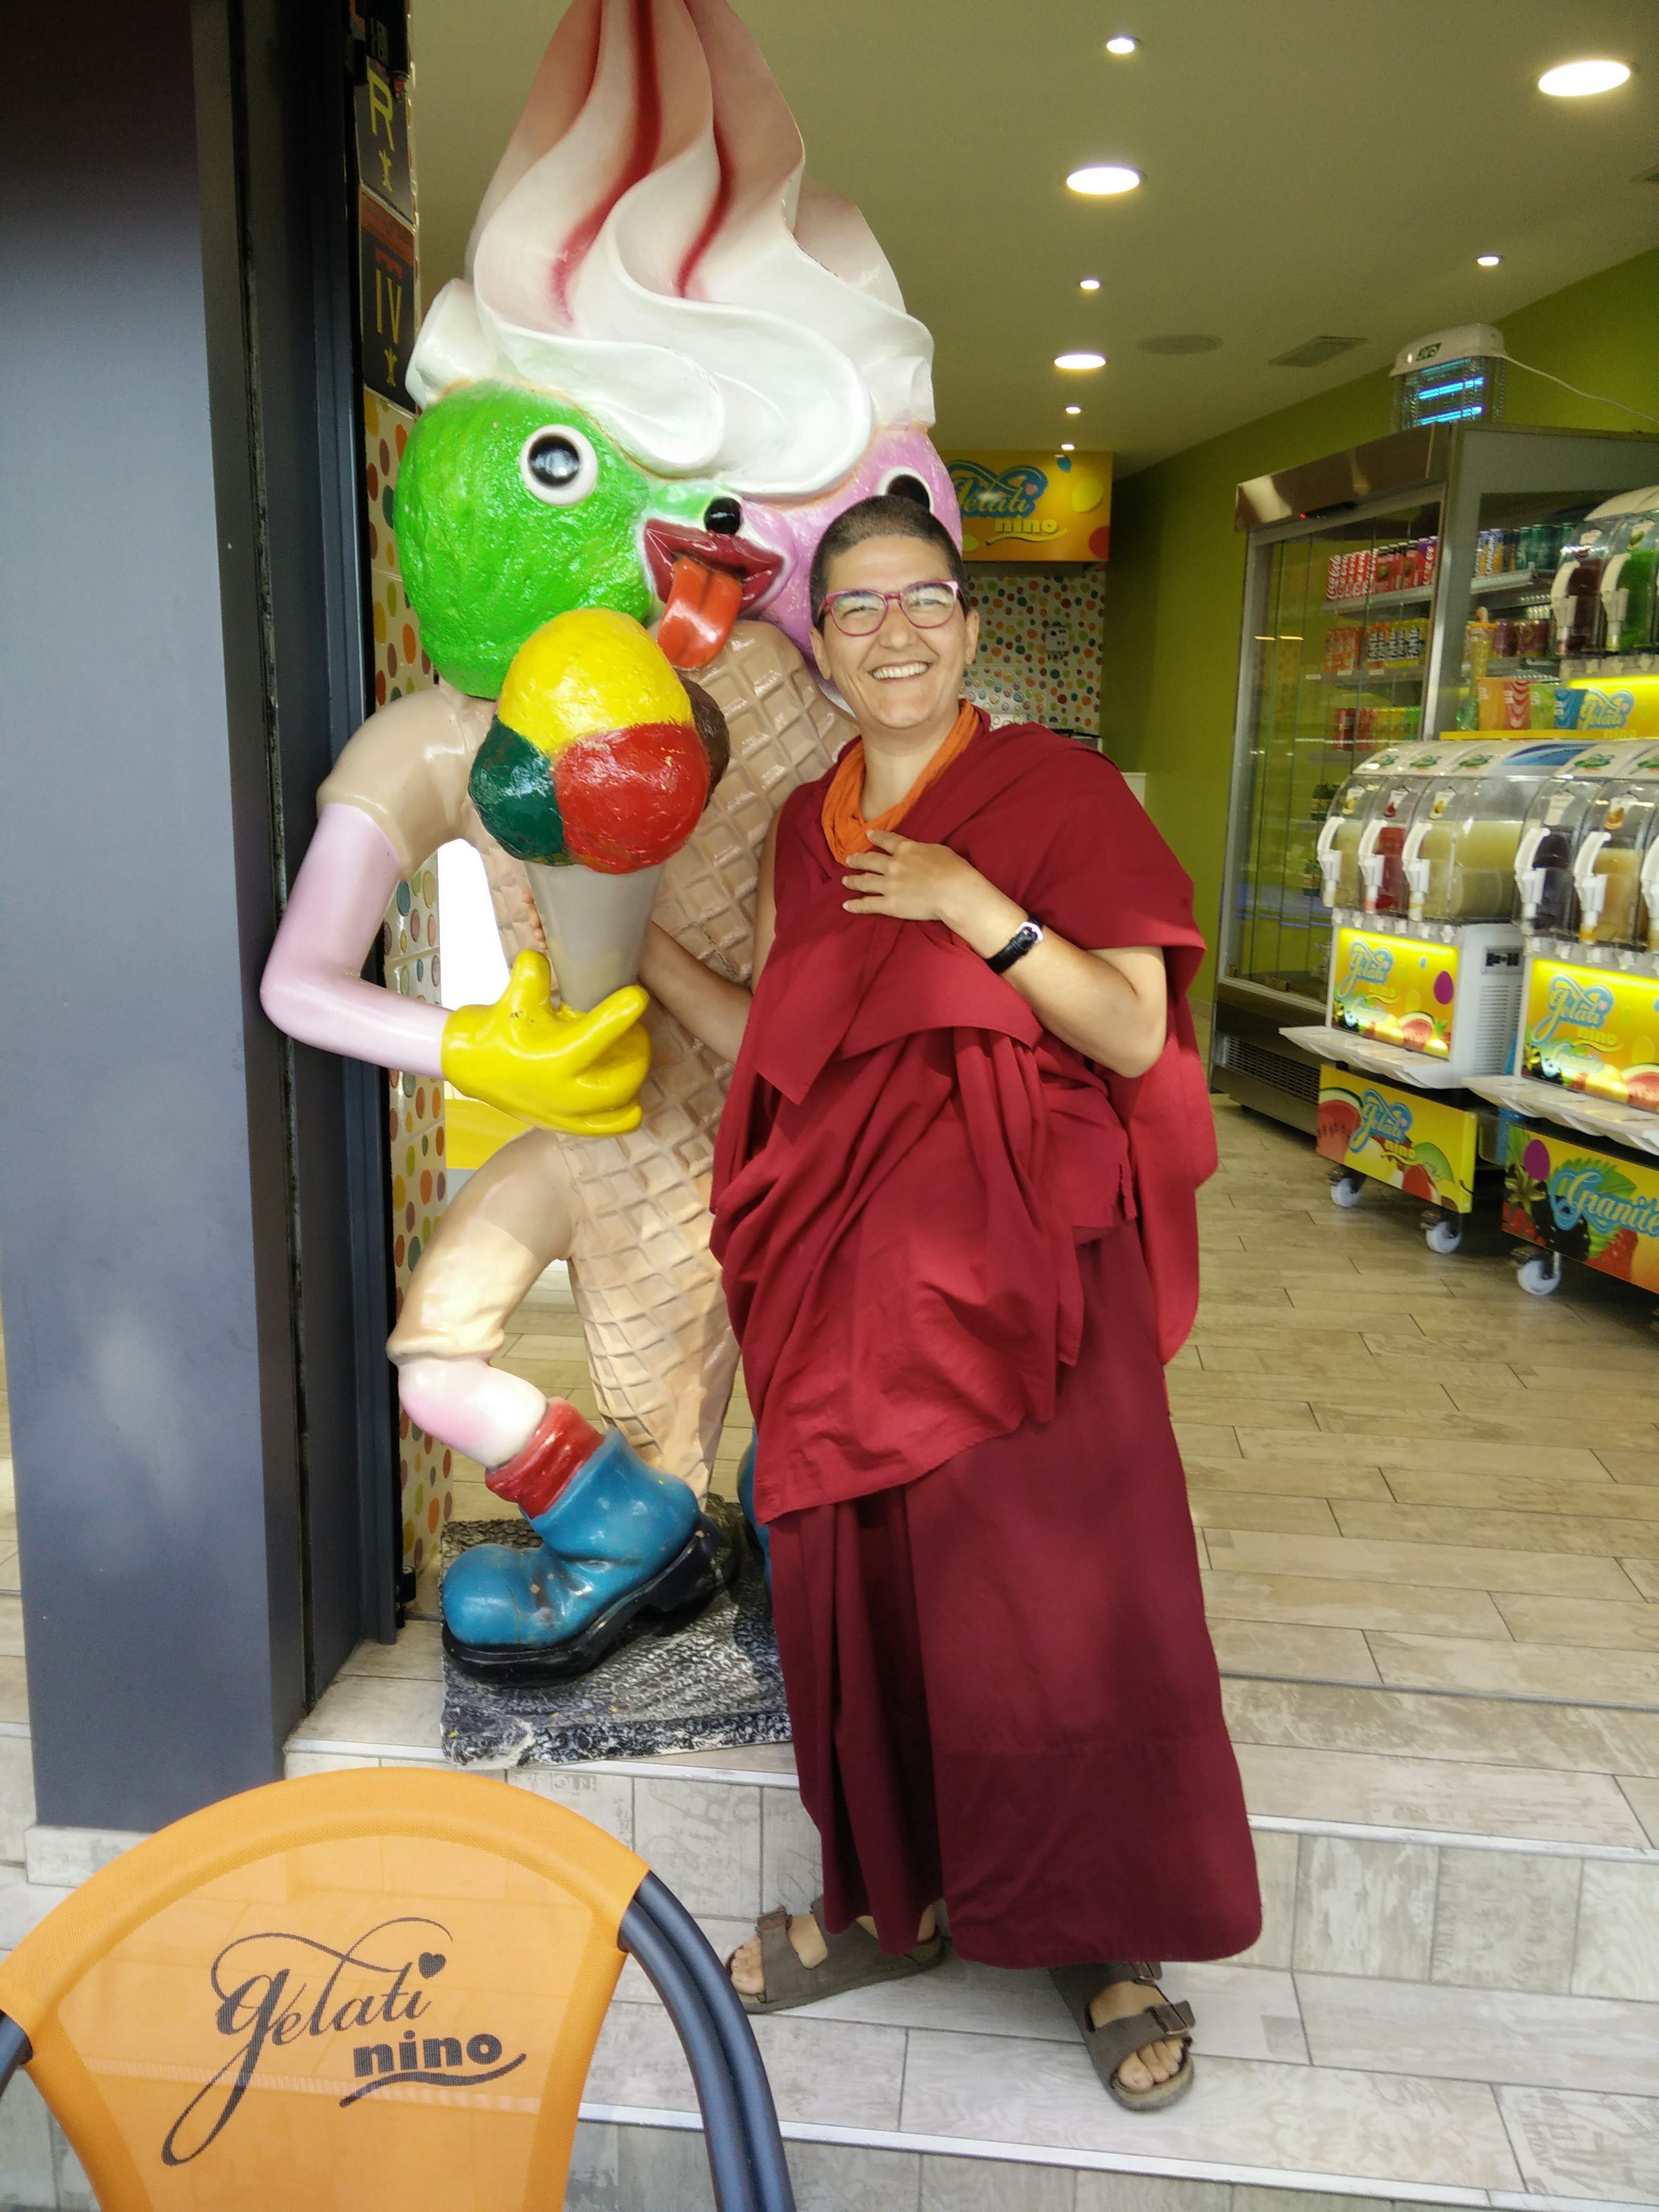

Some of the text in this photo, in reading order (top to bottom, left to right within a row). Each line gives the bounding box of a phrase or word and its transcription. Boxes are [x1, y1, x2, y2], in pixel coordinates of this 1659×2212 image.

[368, 68, 395, 153] R
[995, 514, 1058, 533] nino
[161, 1917, 453, 2166] gelati
[353, 2030, 502, 2078] nino
